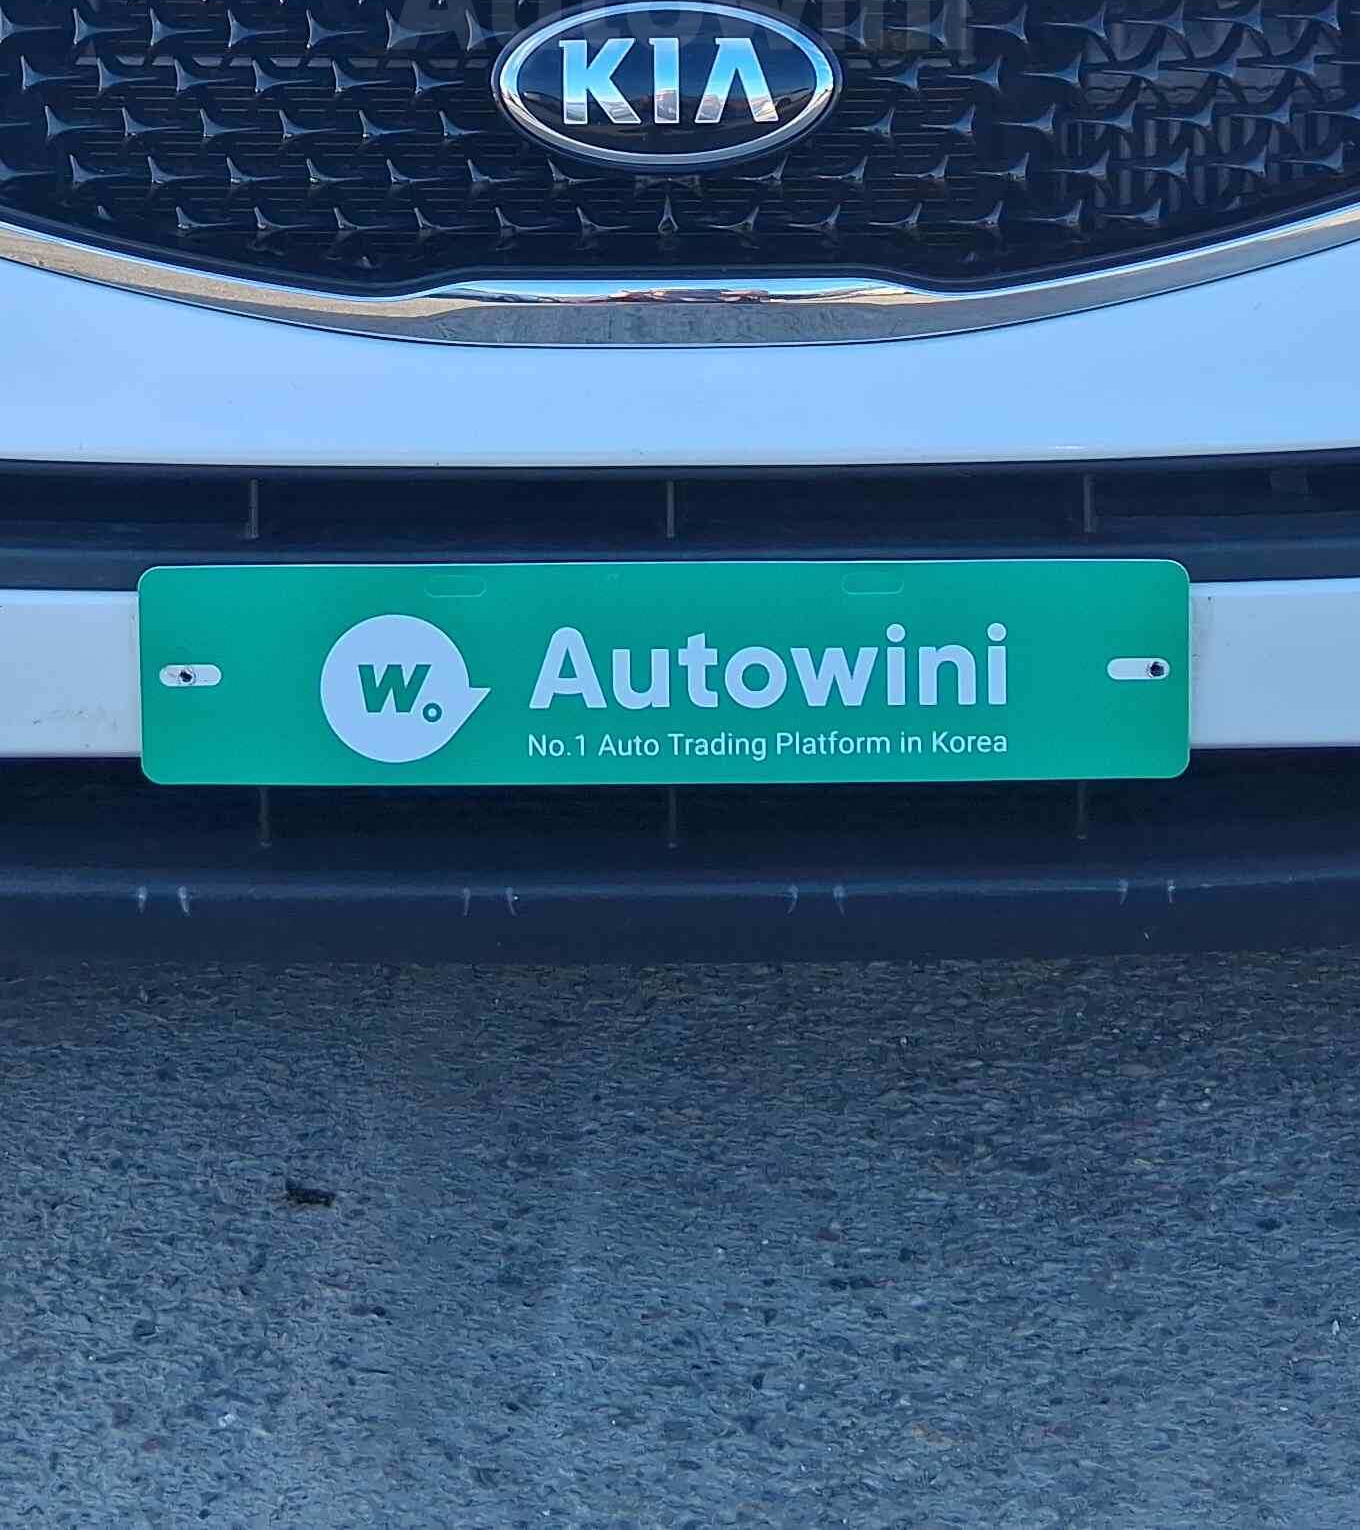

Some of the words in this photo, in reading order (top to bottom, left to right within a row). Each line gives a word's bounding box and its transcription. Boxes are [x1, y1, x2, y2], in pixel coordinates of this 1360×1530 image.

[557, 36, 780, 125] KIA
[528, 622, 1008, 710] Autowini
[527, 733, 585, 757] No.1
[597, 733, 661, 756] Auto
[667, 732, 766, 761] Trading
[775, 730, 891, 755] Platform
[900, 731, 922, 753] in
[931, 730, 1008, 753] Korea
